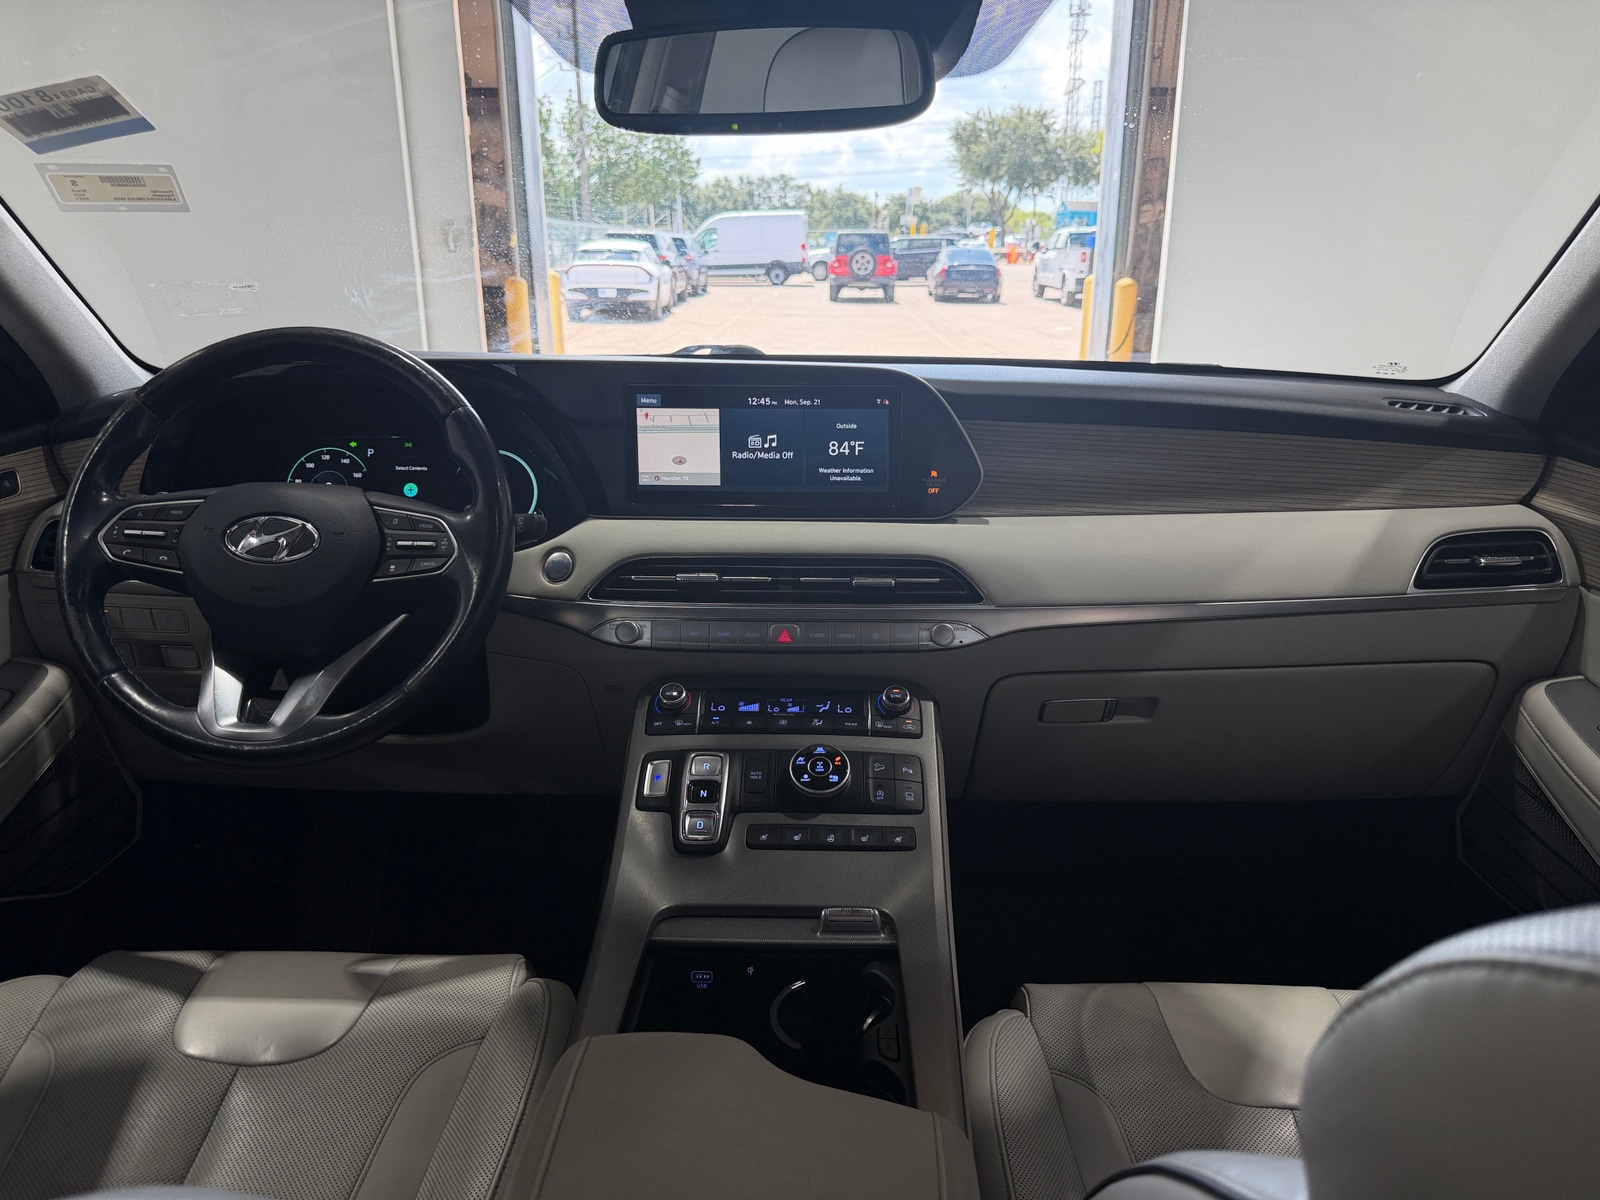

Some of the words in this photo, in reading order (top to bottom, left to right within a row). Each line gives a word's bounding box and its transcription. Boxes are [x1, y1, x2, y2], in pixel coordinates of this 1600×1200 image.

[748, 397, 771, 406] 12:45
[367, 449, 375, 457] P
[828, 441, 865, 456] 84°F
[732, 451, 780, 460] Radio/Media
[781, 451, 794, 459] Off
[927, 487, 940, 495] OFF
[654, 773, 662, 782] P
[696, 821, 704, 829] D
